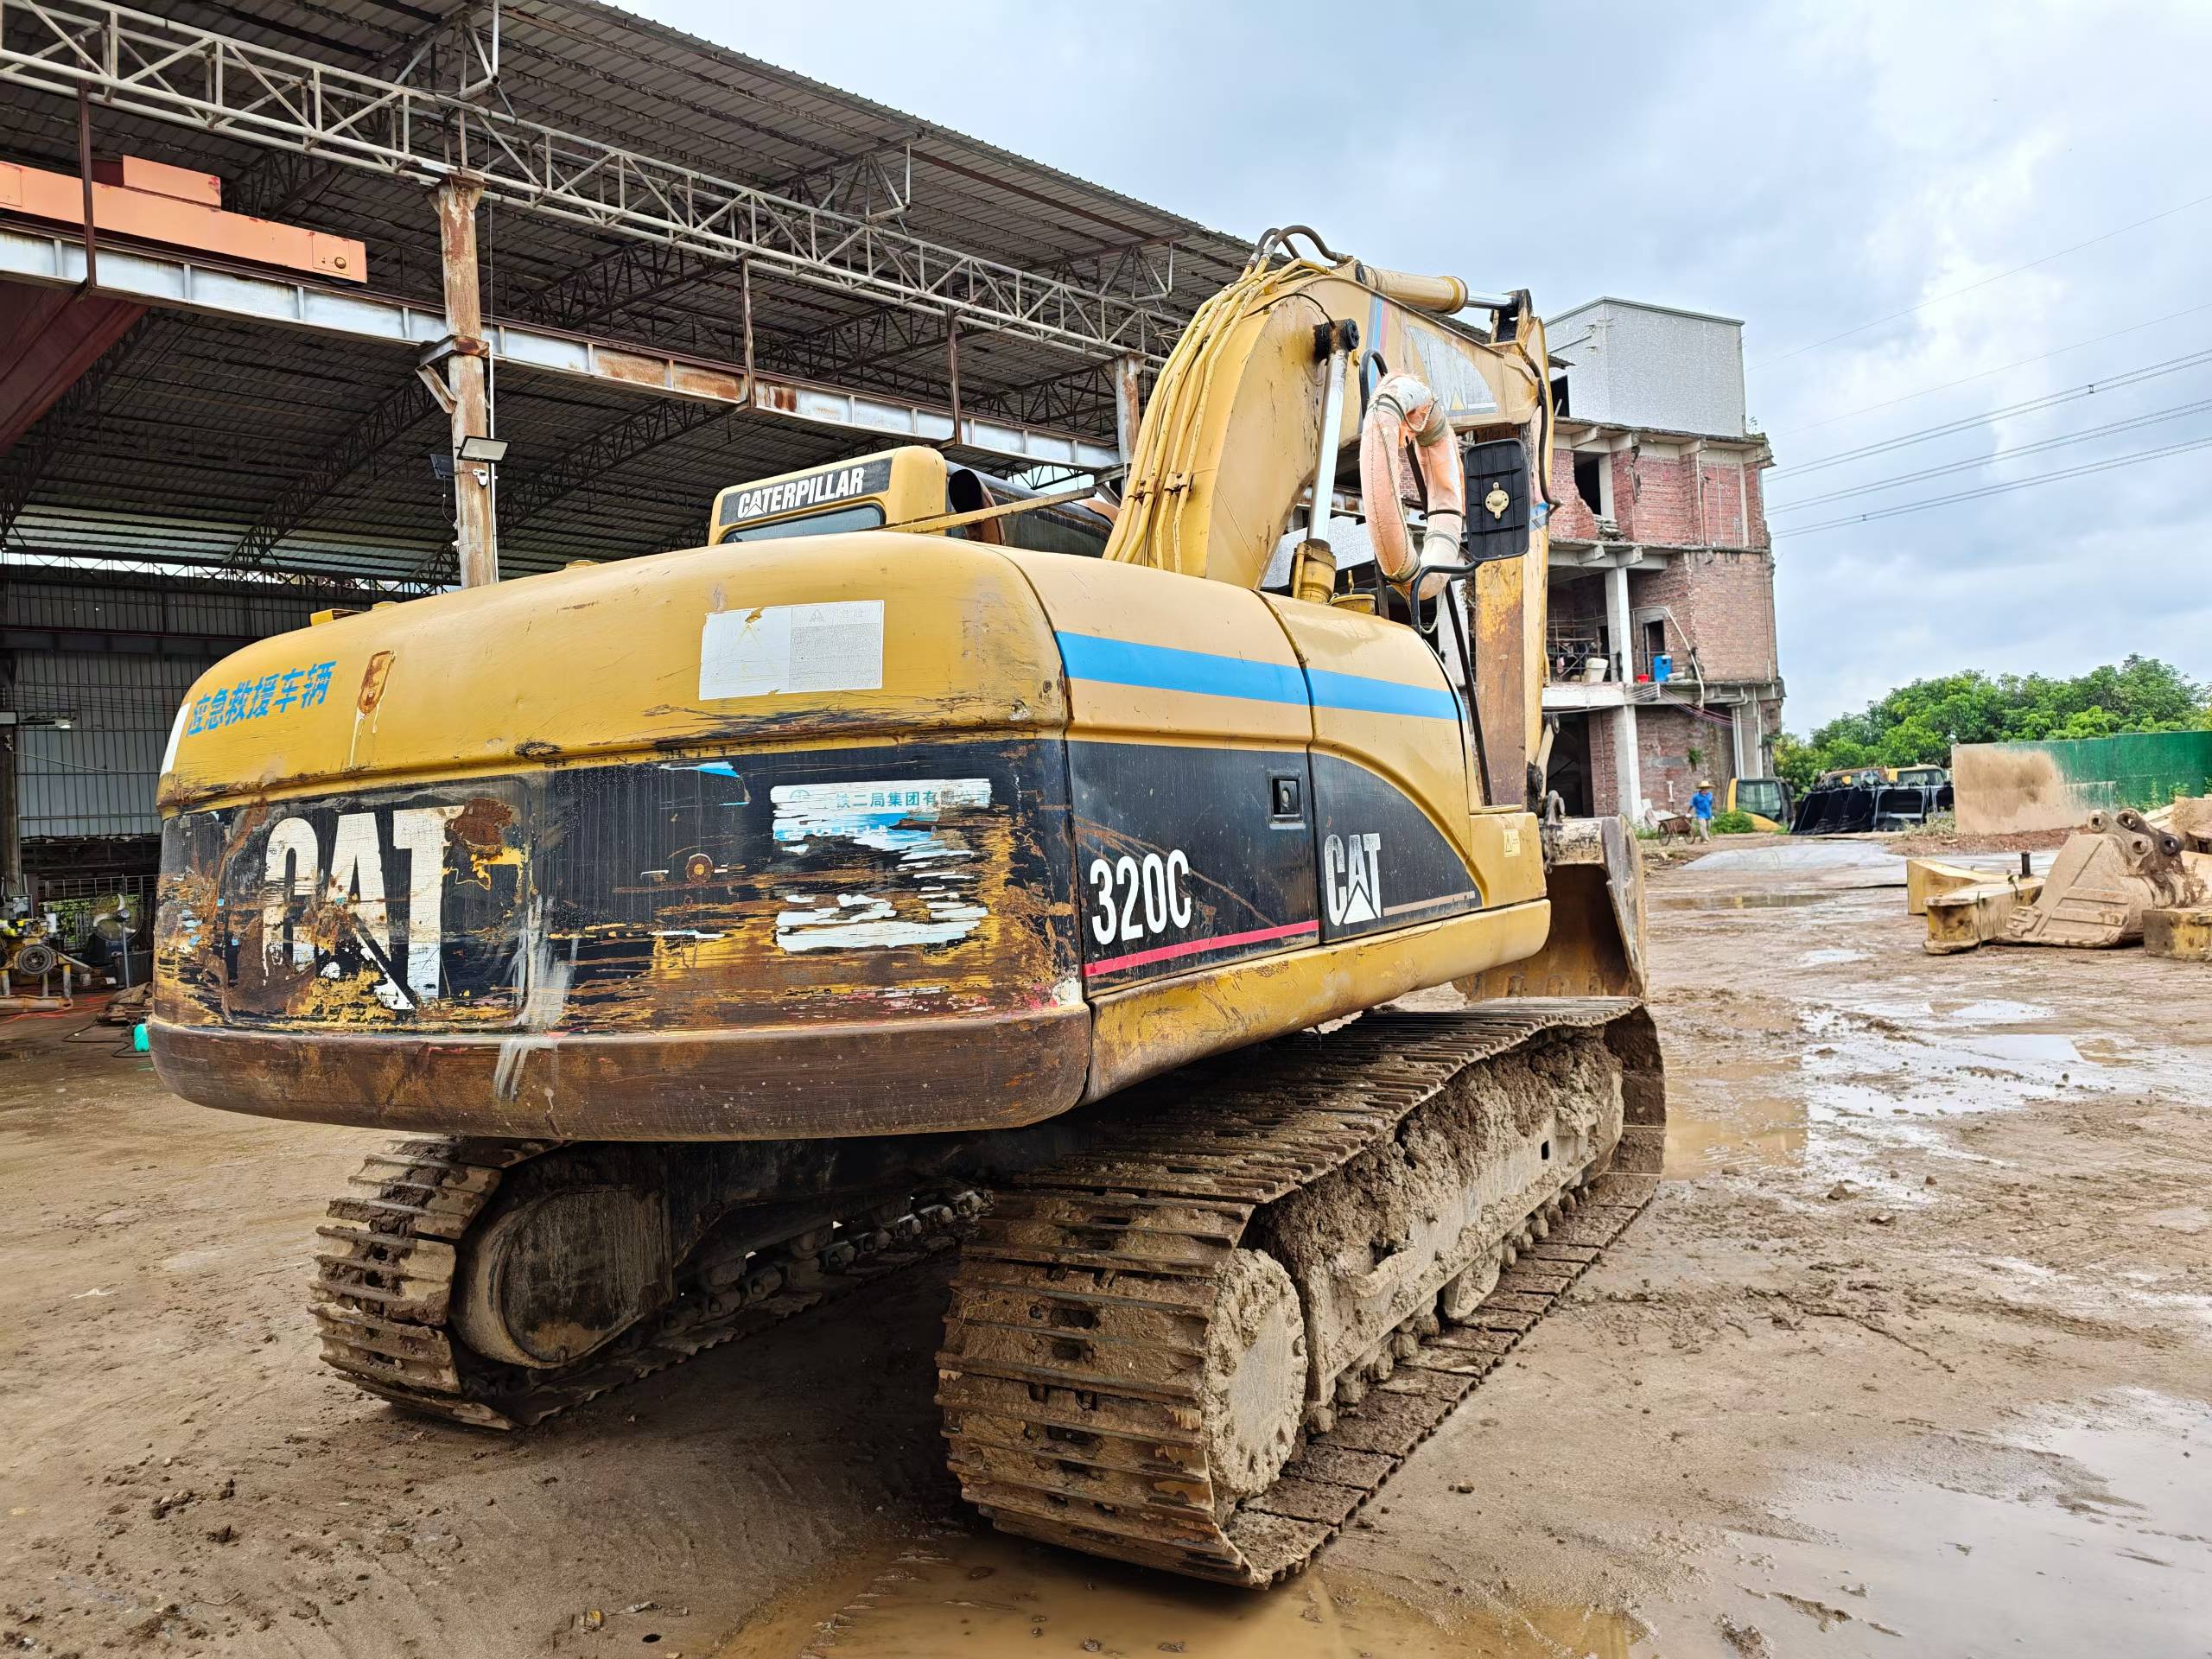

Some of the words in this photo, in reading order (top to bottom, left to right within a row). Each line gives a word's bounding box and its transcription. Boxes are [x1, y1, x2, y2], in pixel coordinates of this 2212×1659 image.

[737, 467, 866, 518] CATERPILLAR
[186, 660, 337, 737] 应急救援车辆
[1090, 849, 1192, 944] 320C
[1324, 832, 1382, 926] CAT
